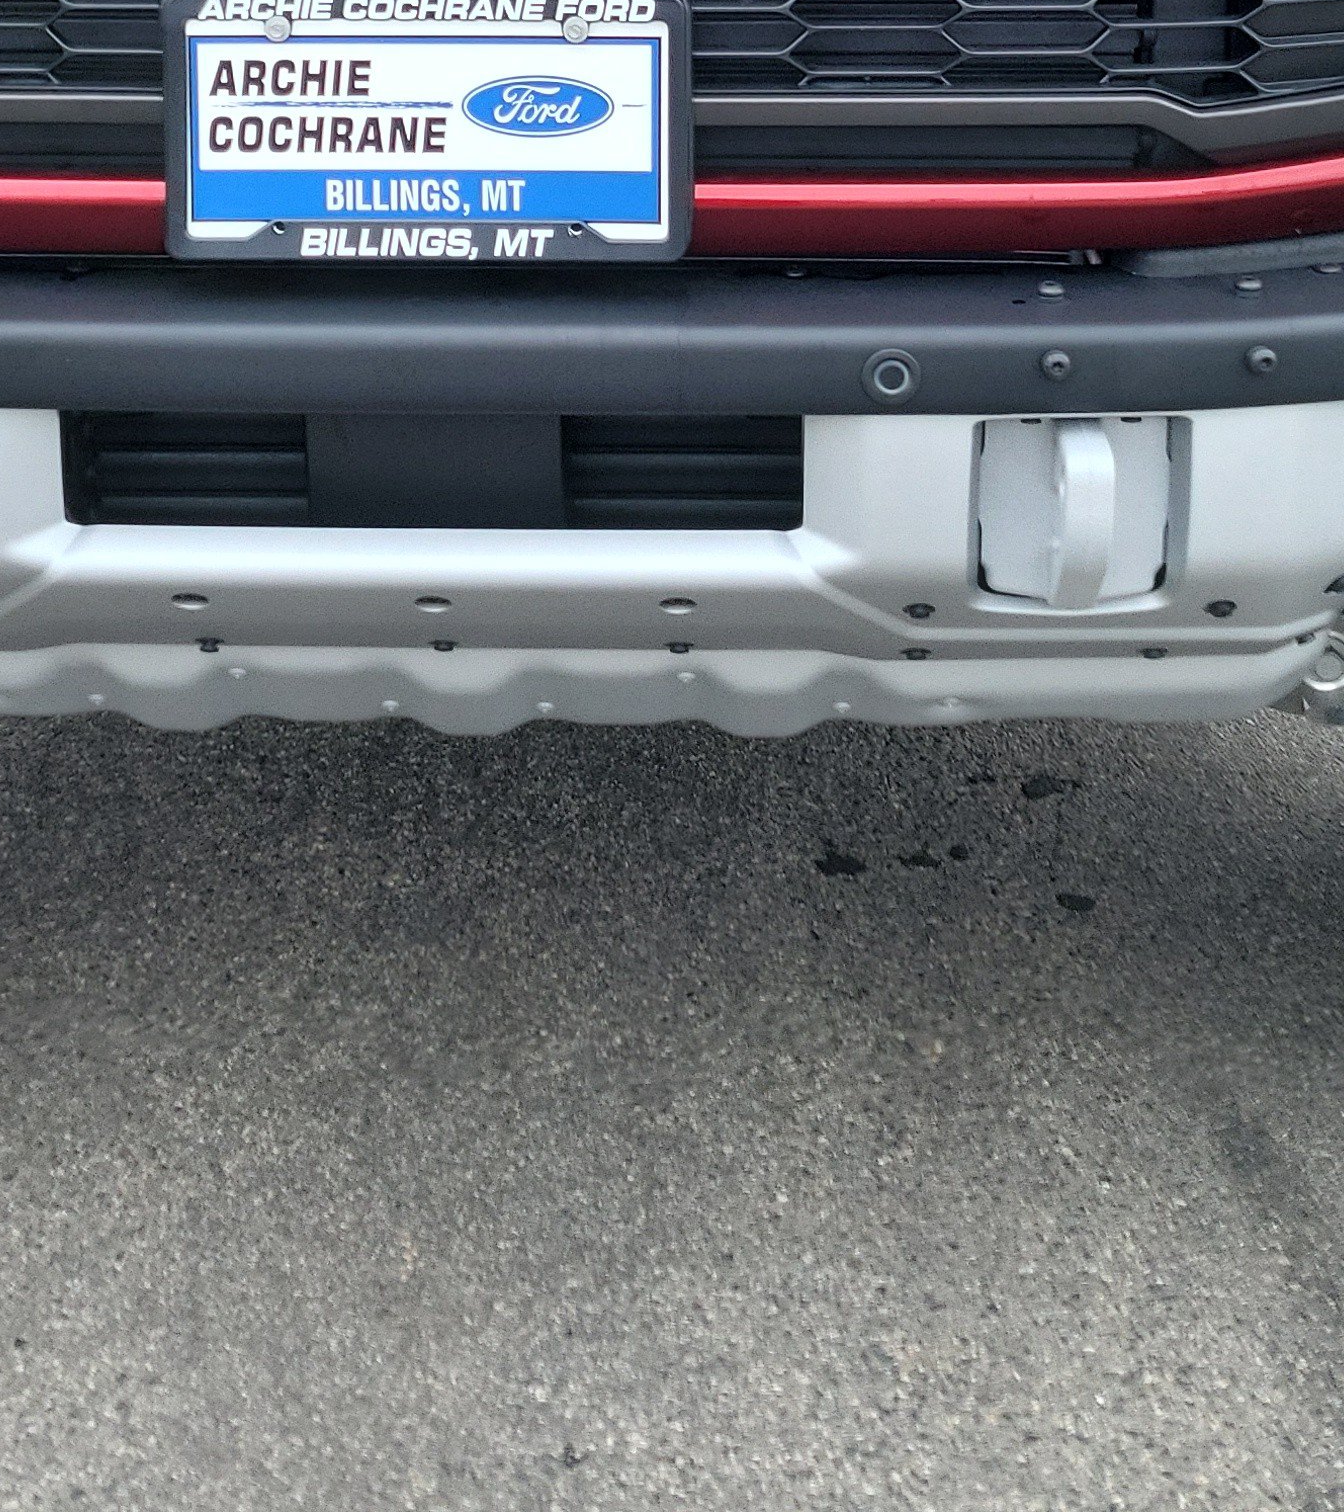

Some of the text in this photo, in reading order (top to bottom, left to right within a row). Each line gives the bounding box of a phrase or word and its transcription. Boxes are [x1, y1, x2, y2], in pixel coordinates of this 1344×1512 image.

[208, 59, 372, 97] ARCHIE
[492, 83, 582, 126] Ford
[208, 115, 448, 154] COCHRANE
[324, 178, 526, 217] BILLINGS, MT
[299, 228, 555, 260] BILLINGS, MT
